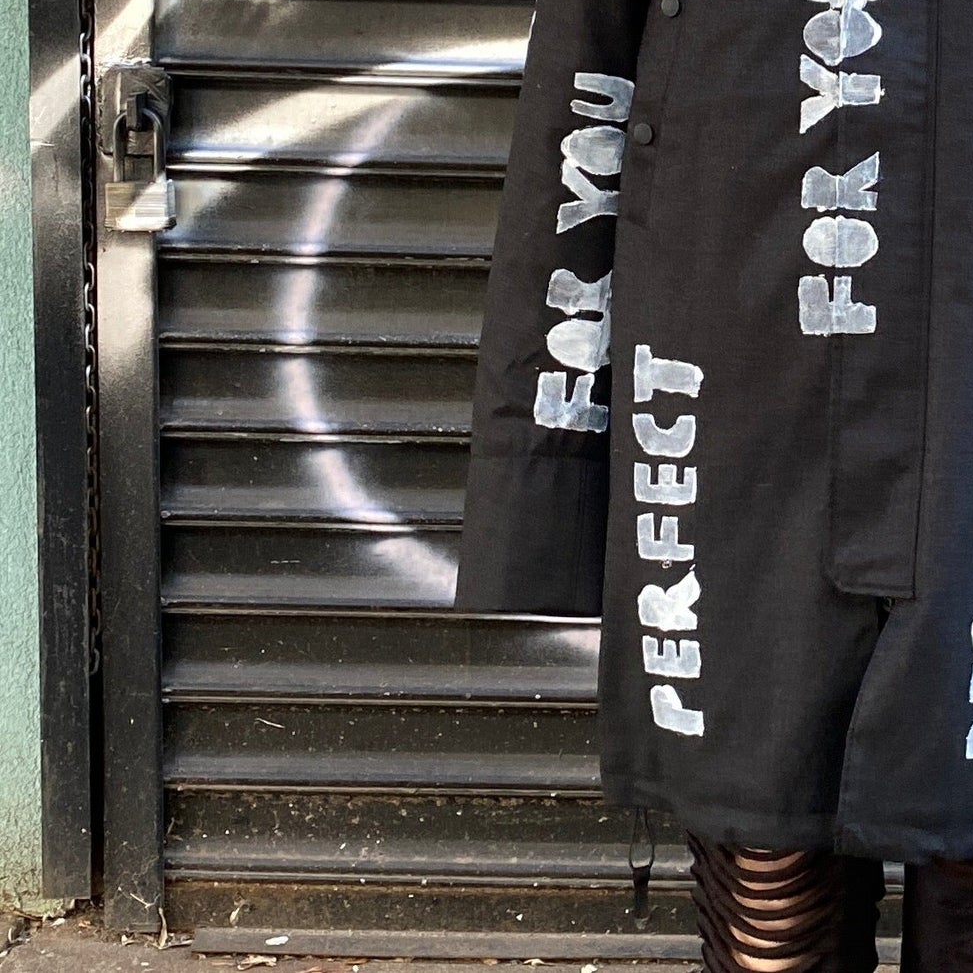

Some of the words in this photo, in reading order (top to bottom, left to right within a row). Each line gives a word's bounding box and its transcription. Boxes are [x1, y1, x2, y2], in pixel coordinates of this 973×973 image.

[556, 72, 635, 234] YOU
[797, 151, 881, 338] FOR
[632, 344, 704, 737] PERFECT
